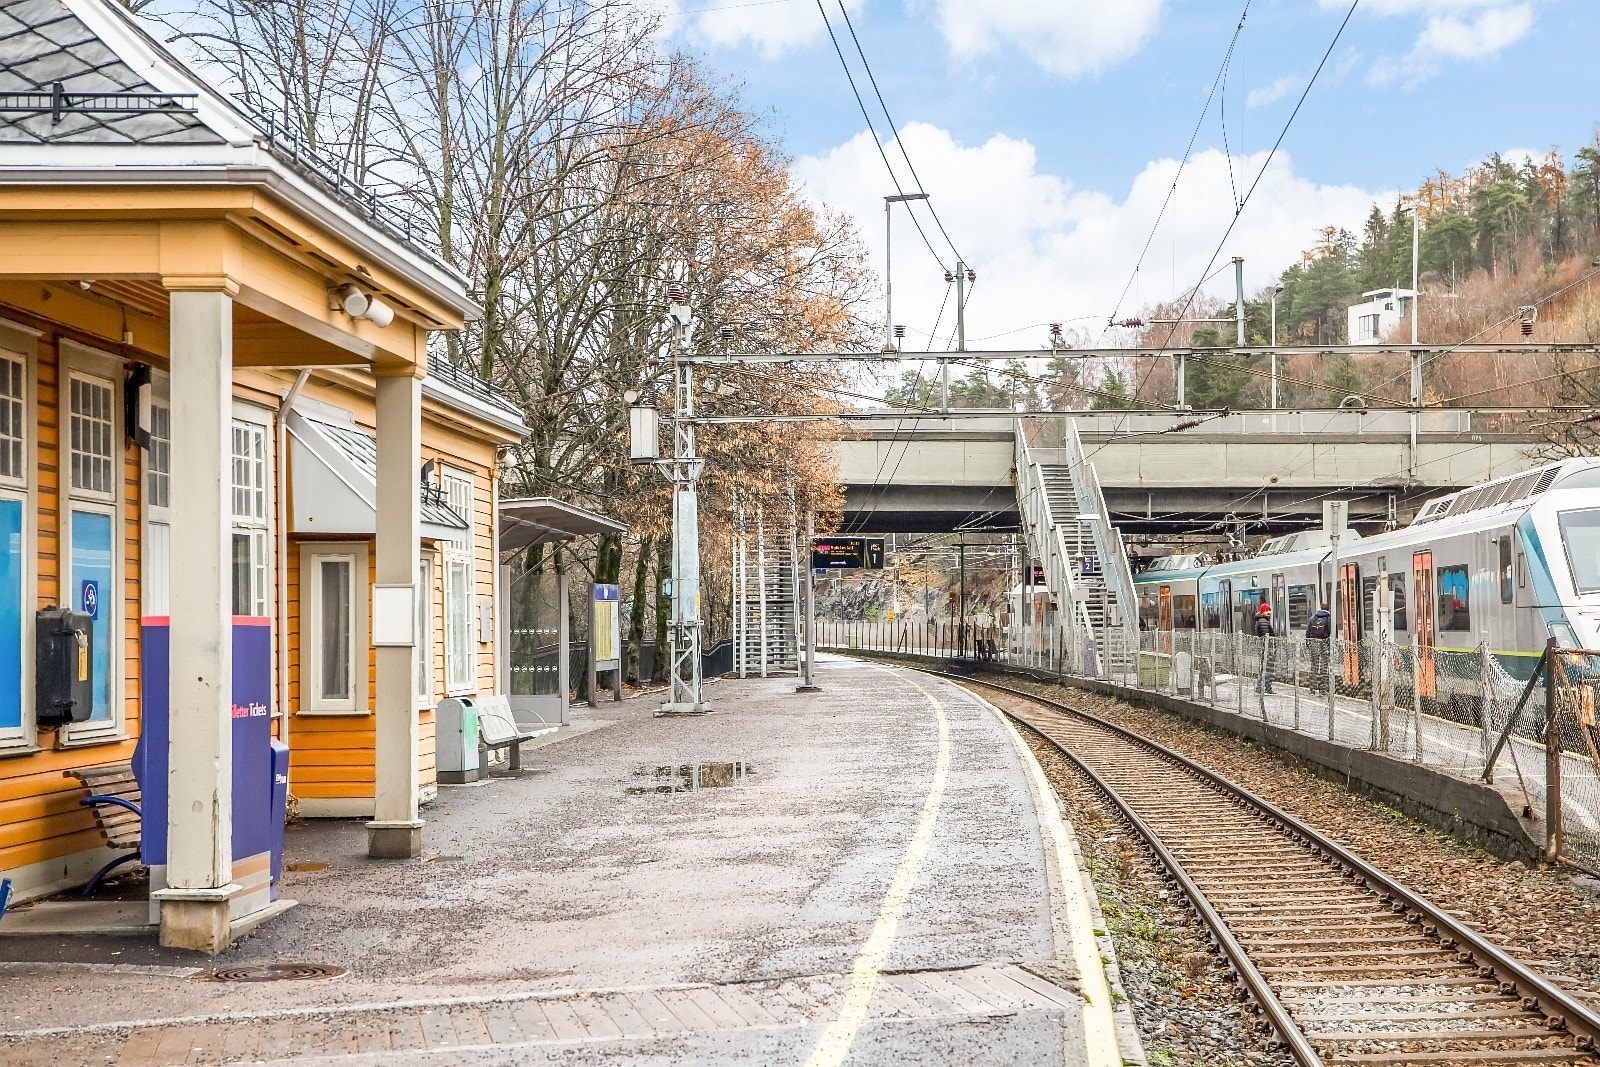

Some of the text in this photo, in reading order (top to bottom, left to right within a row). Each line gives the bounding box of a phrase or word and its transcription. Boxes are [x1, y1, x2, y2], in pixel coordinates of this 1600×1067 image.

[872, 553, 877, 564] 1
[1085, 562, 1091, 570] 2
[249, 701, 267, 717] Tickets
